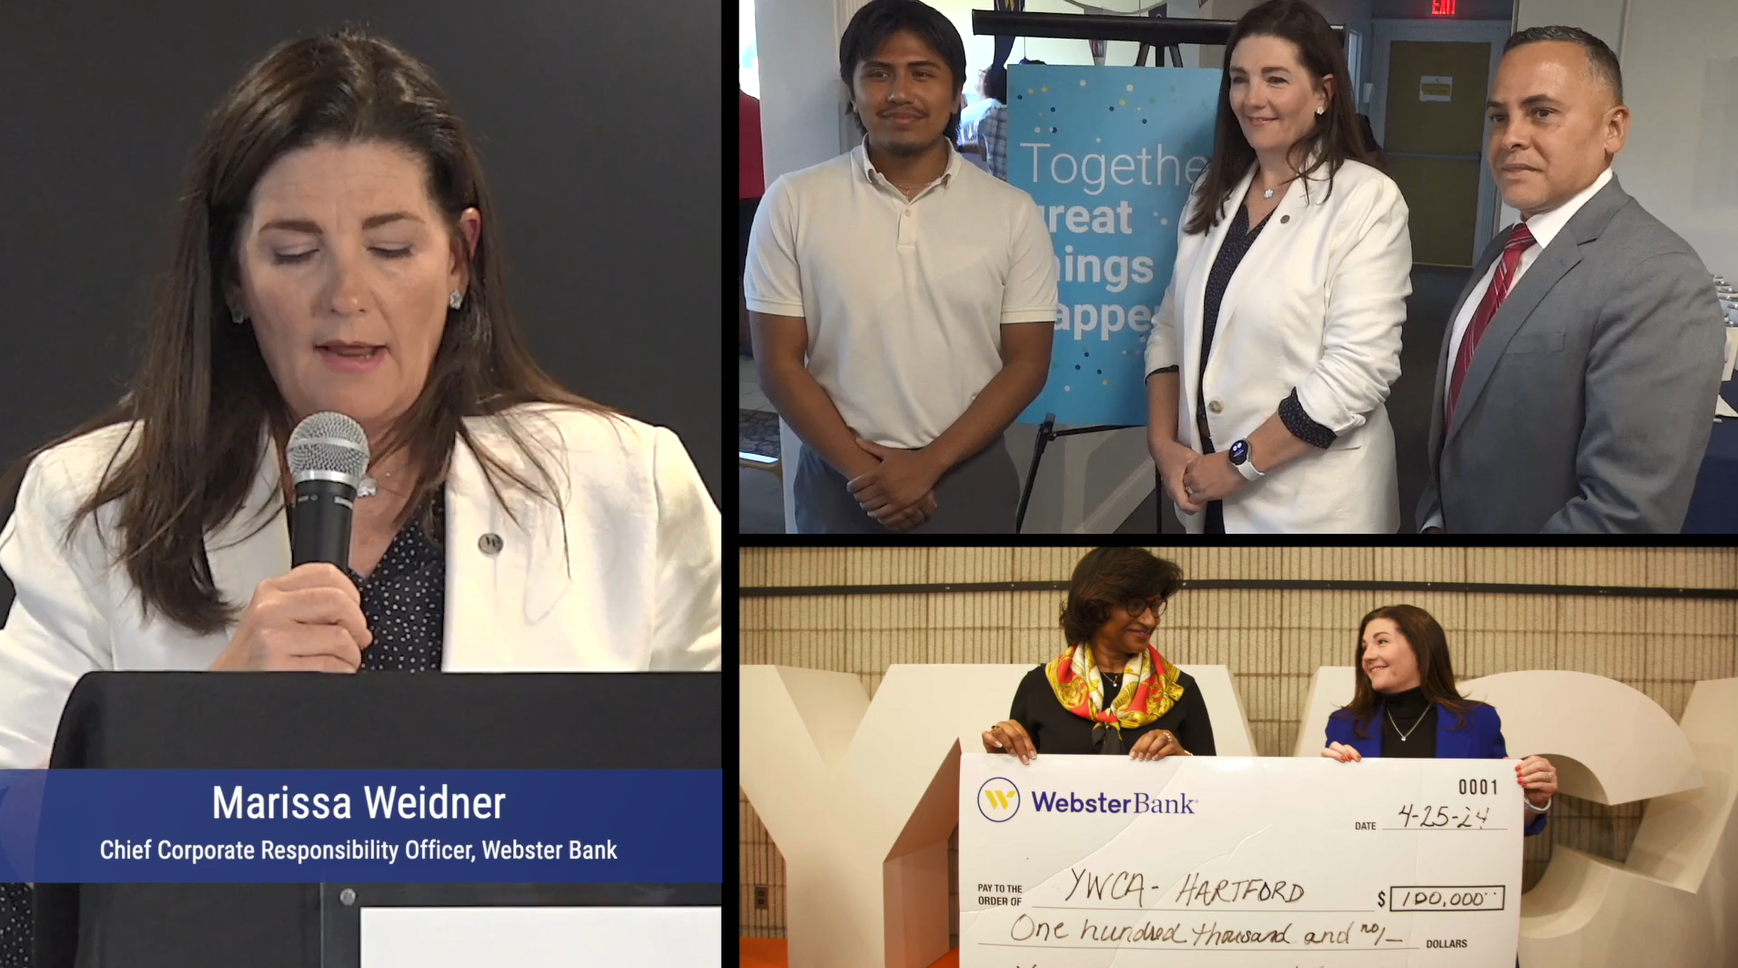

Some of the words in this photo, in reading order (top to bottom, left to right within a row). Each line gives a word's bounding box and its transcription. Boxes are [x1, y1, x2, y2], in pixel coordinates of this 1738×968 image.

[1020, 142, 1209, 196] Togethe
[1037, 200, 1133, 235] reat
[1054, 244, 1154, 293] ings
[1053, 302, 1161, 341] appe
[1458, 778, 1498, 796] 0001
[1354, 821, 1377, 831] DATE
[1398, 803, 1490, 830] 4-25-24
[977, 883, 993, 893] PAY
[995, 884, 1005, 893] TO
[1007, 884, 1023, 894] THE
[978, 896, 1008, 906] ORDER
[1010, 897, 1022, 907] OF
[1175, 872, 1305, 907] HARTFORD
[1377, 890, 1386, 908] $
[1010, 913, 1070, 942] One
[1080, 918, 1188, 944] hundred
[1191, 921, 1293, 947] thousand
[1303, 920, 1355, 945] and
[1426, 939, 1468, 949] DOLLARS
